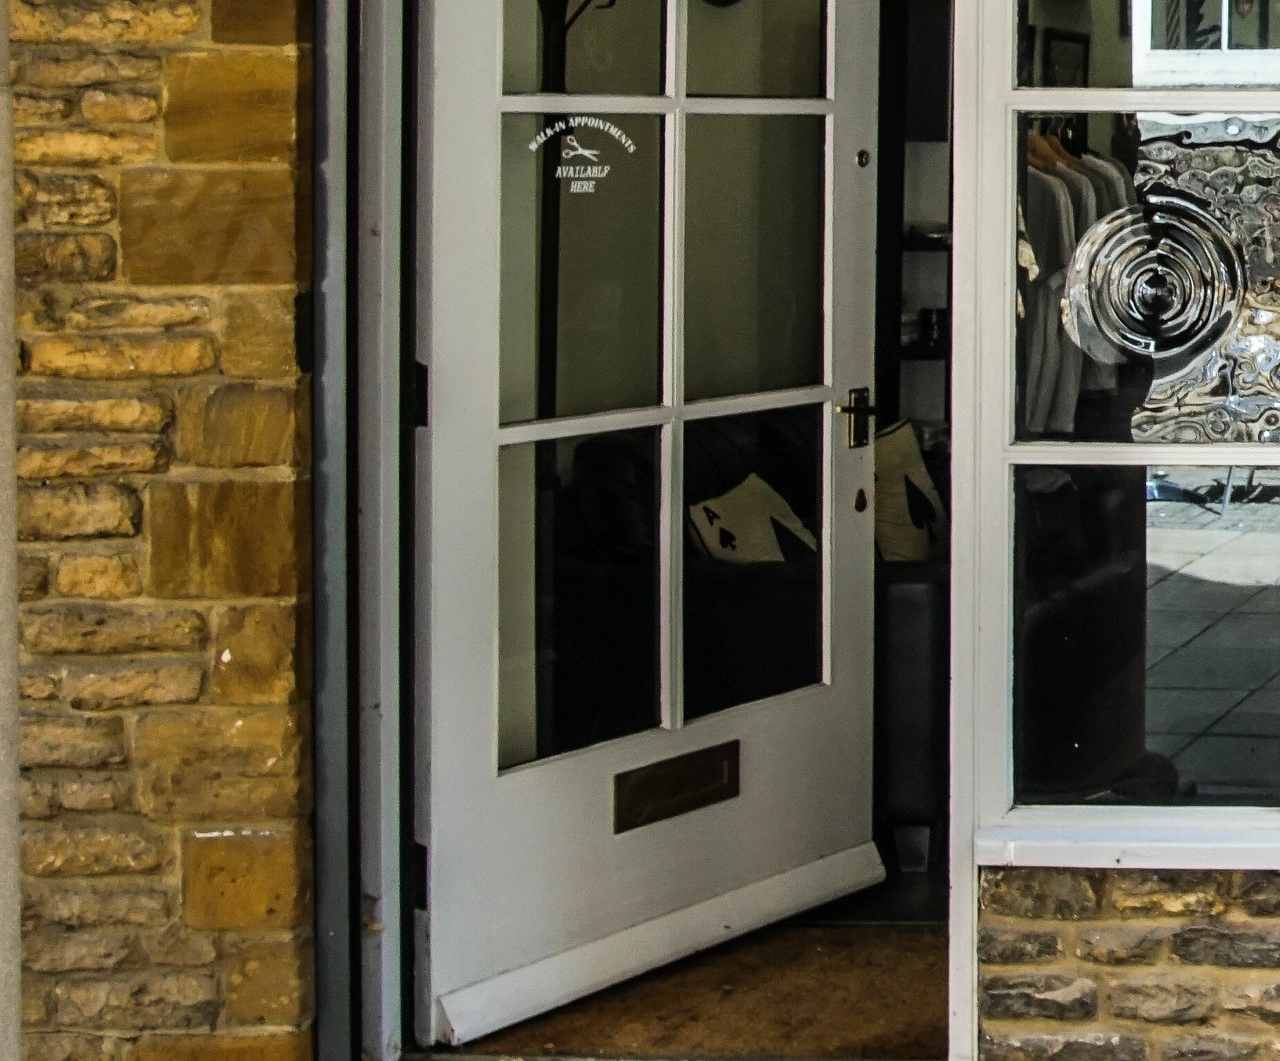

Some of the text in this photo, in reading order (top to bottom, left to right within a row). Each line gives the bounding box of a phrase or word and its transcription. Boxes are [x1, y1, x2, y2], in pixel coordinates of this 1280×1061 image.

[528, 116, 637, 154] WALK-IN APPOINTMENTS
[569, 180, 597, 194] HERE
